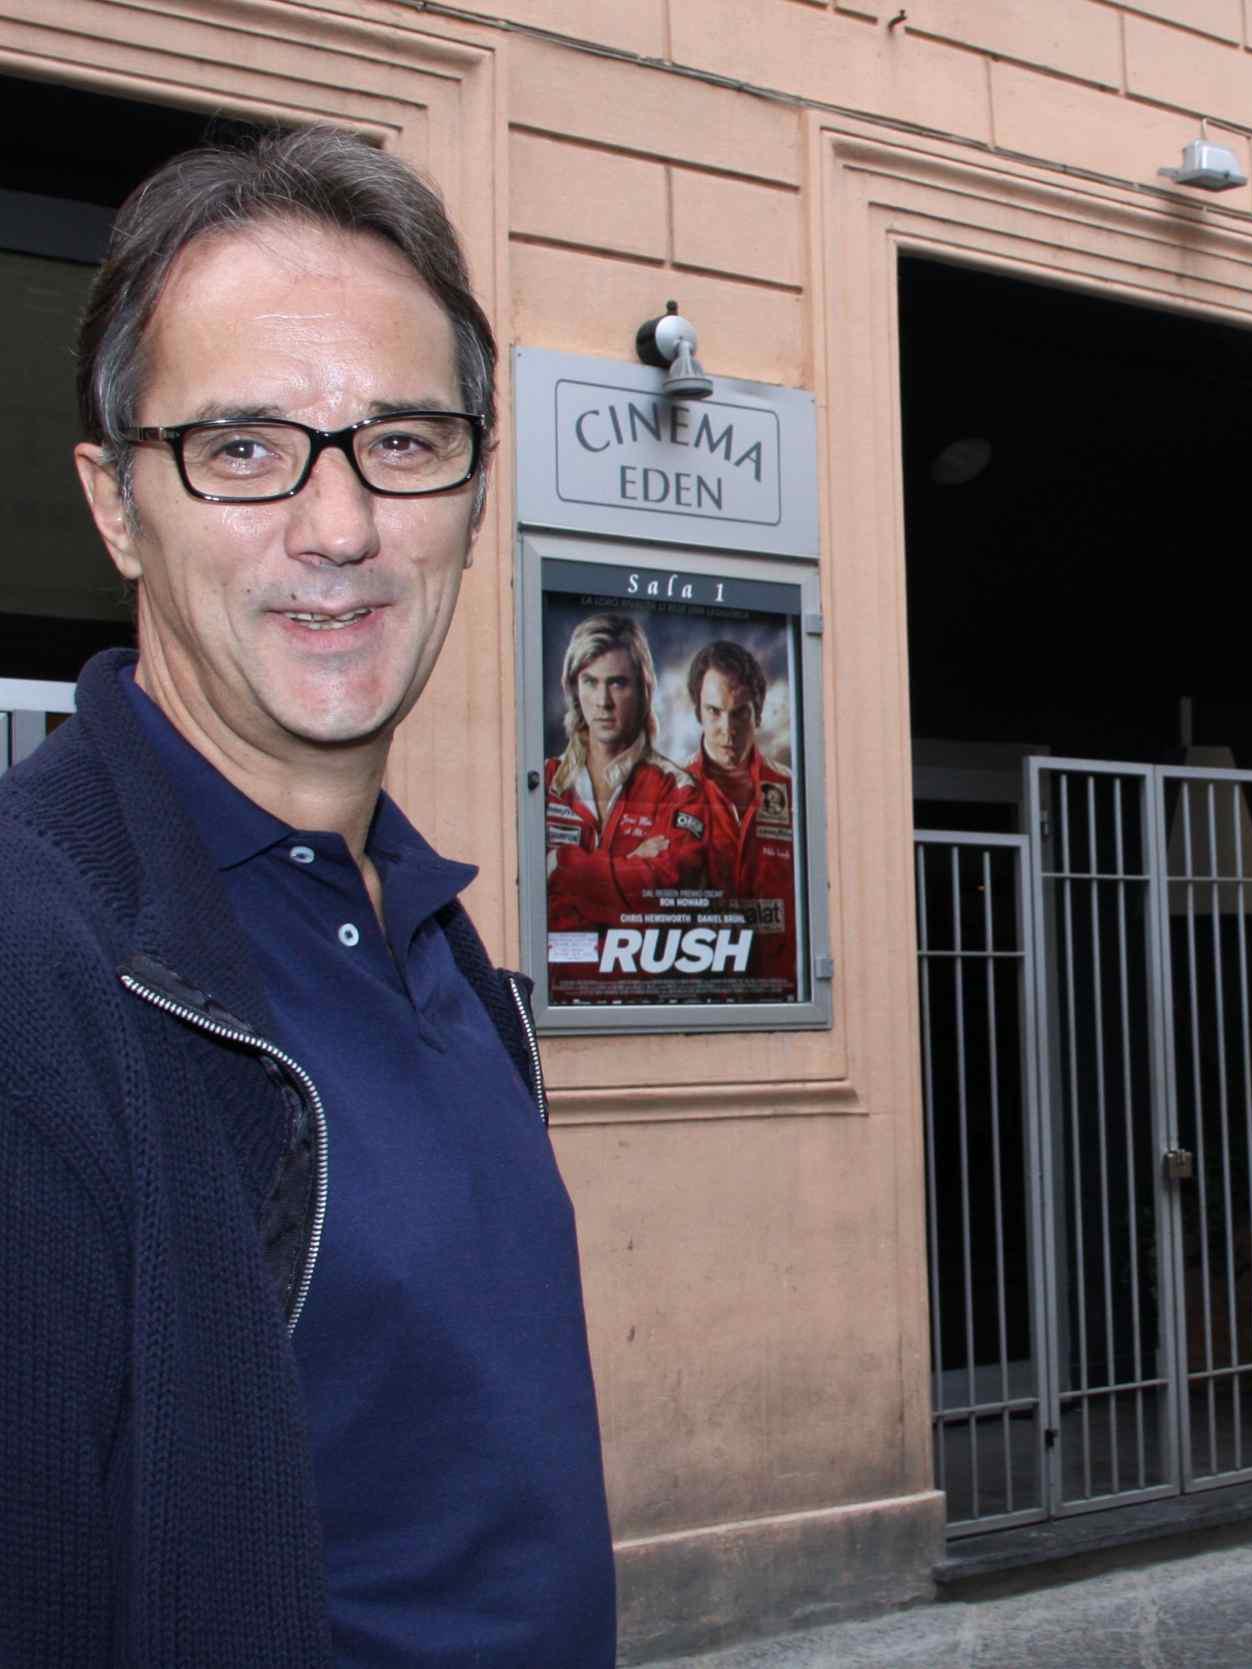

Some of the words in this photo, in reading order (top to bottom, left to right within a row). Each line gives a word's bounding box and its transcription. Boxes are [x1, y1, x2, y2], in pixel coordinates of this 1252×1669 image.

[574, 401, 764, 483] CINEMA
[619, 464, 723, 511] EDEN
[627, 573, 693, 600] Sala
[714, 583, 725, 602] 1
[599, 928, 753, 974] RUSH
